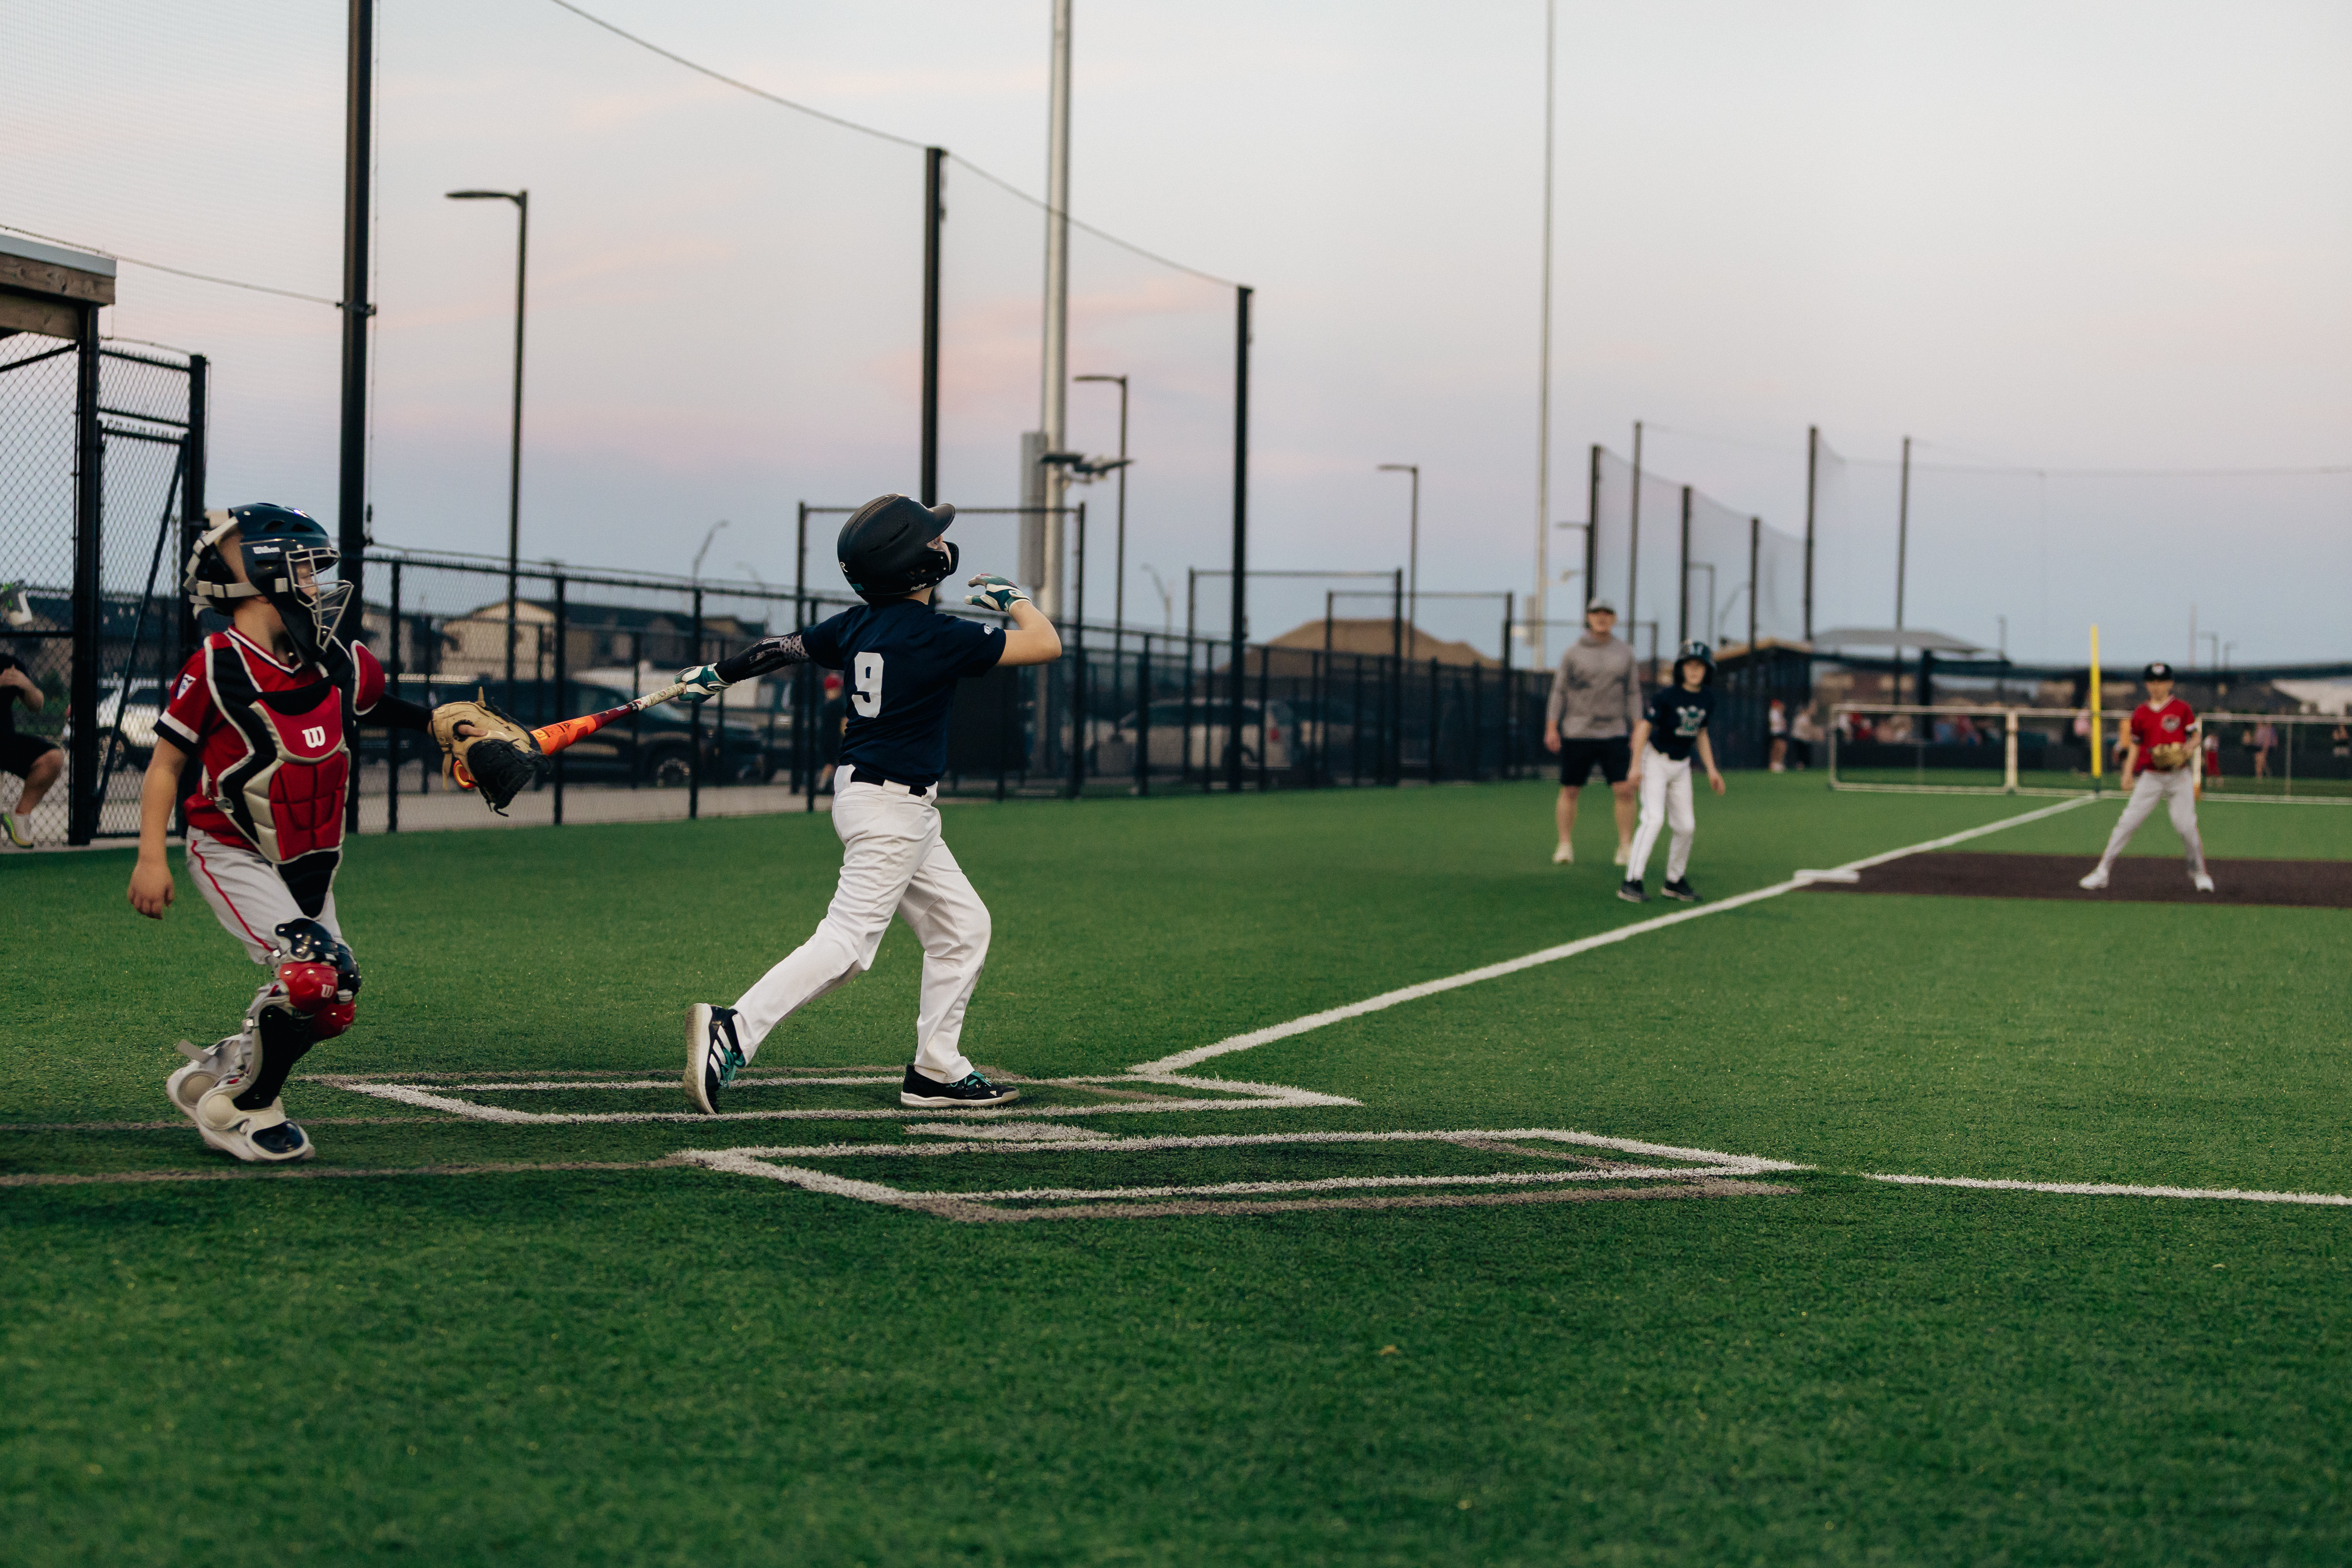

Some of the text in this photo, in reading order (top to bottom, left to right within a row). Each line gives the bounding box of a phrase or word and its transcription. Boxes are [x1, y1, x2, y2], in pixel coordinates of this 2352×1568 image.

[840, 562, 848, 572] R
[851, 652, 884, 718] 9
[301, 726, 326, 748] W
[321, 984, 334, 998] W
